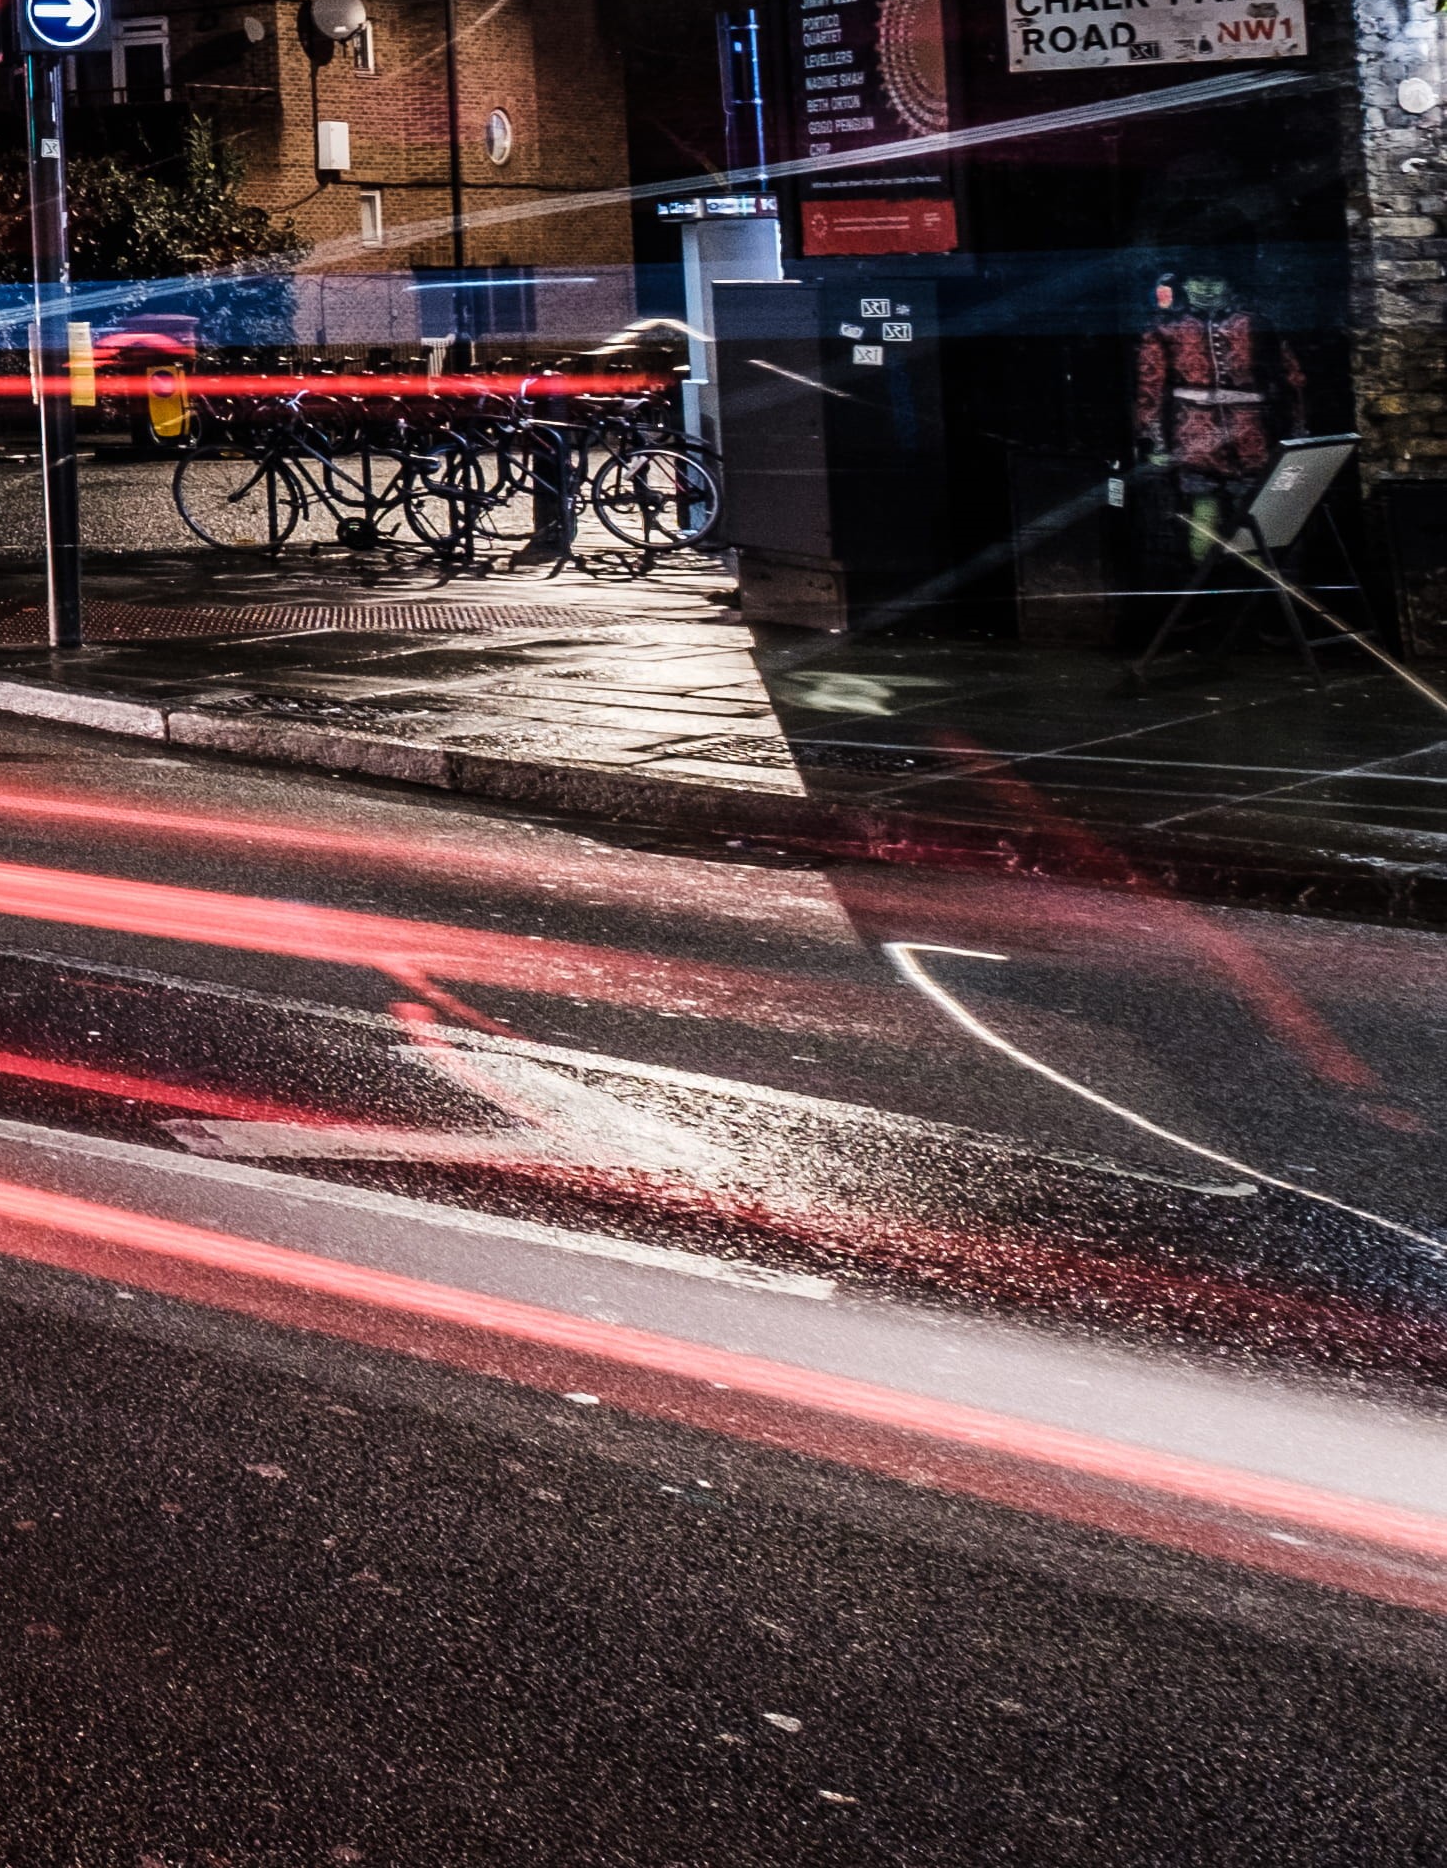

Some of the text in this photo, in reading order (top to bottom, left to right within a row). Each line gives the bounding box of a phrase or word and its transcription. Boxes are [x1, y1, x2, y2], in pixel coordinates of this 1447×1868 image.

[1023, 18, 1293, 55] ROAD NW1
[804, 51, 854, 68] LEVELLERS
